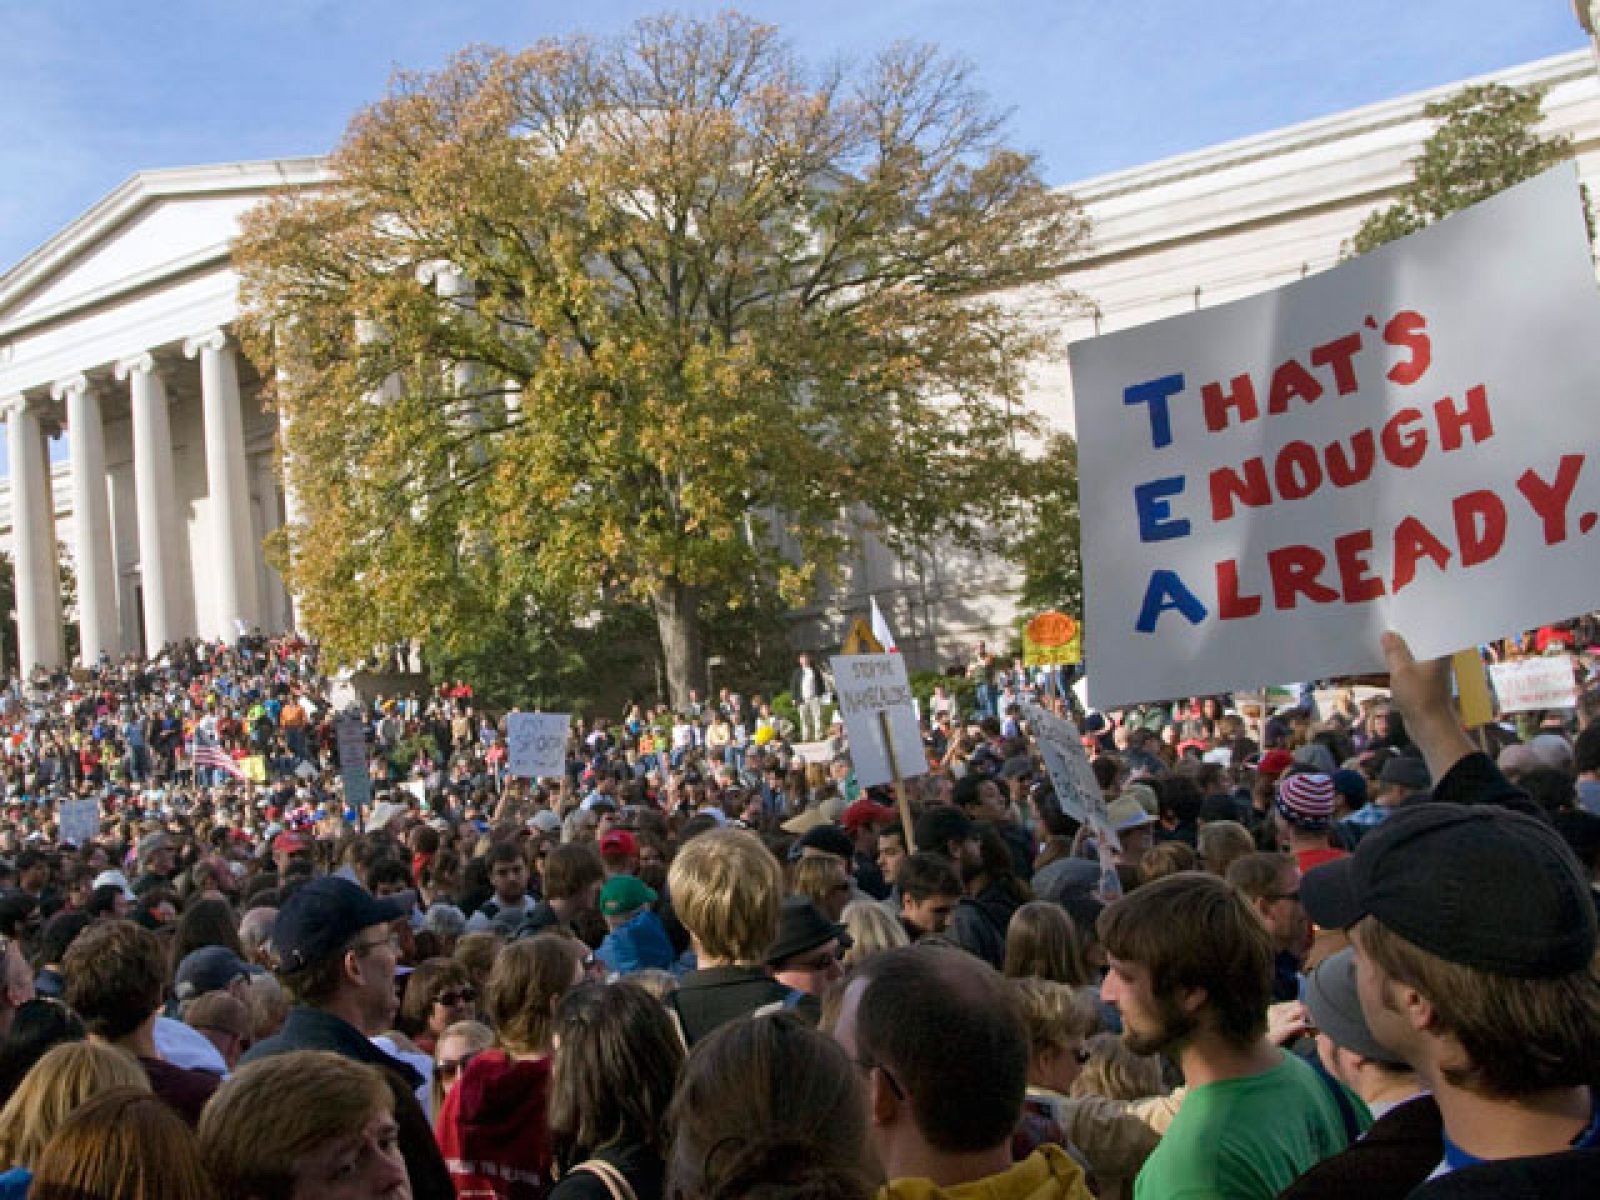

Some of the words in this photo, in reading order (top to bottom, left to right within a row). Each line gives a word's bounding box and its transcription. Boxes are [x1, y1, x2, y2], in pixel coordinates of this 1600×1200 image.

[1123, 310, 1432, 447] THAT'S
[1134, 384, 1494, 542] ENOUGH
[1135, 454, 1599, 634] ALREADY.
